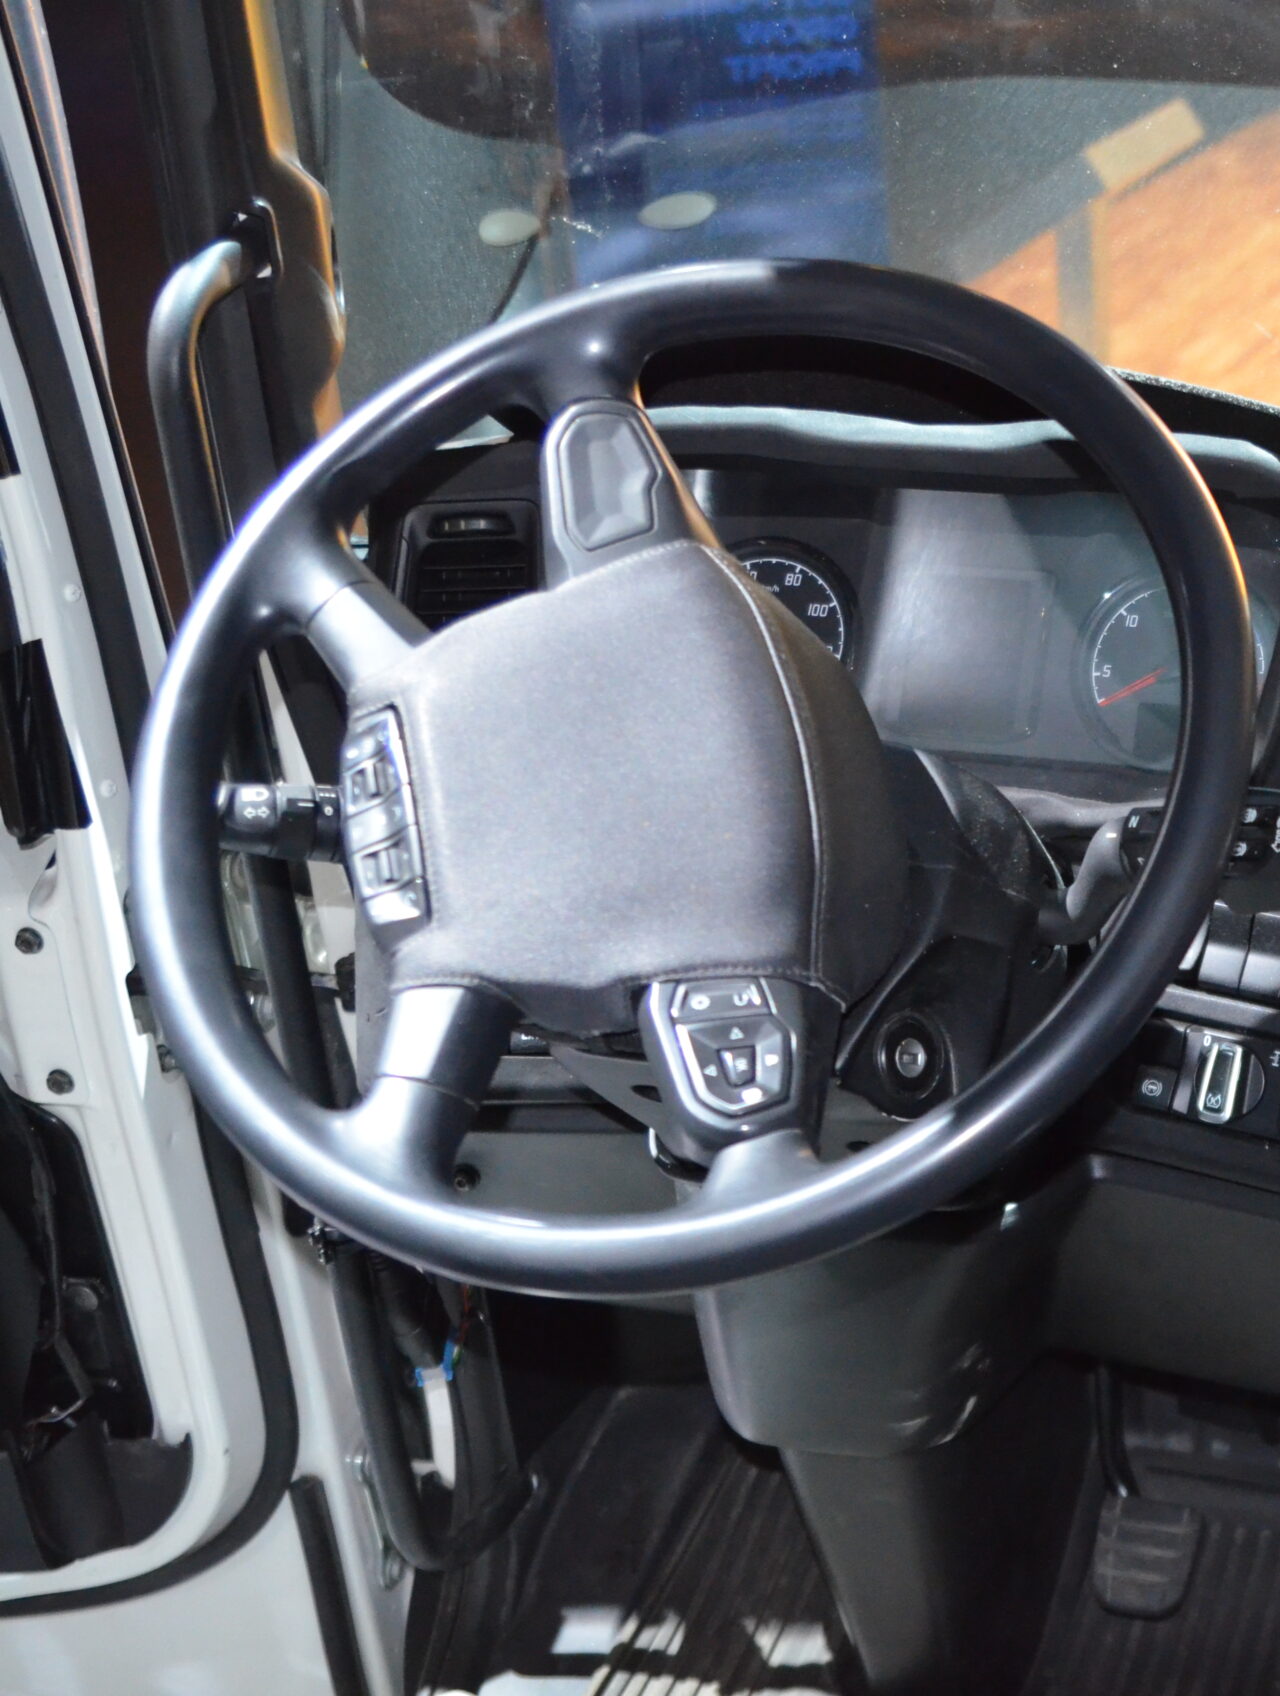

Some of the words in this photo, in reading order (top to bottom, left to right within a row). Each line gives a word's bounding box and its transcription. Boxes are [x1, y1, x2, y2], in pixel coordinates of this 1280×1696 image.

[785, 573, 802, 587] 80
[808, 603, 829, 617] 100
[1125, 615, 1139, 628] 10
[1102, 664, 1112, 678] 5
[1128, 815, 1140, 828] N
